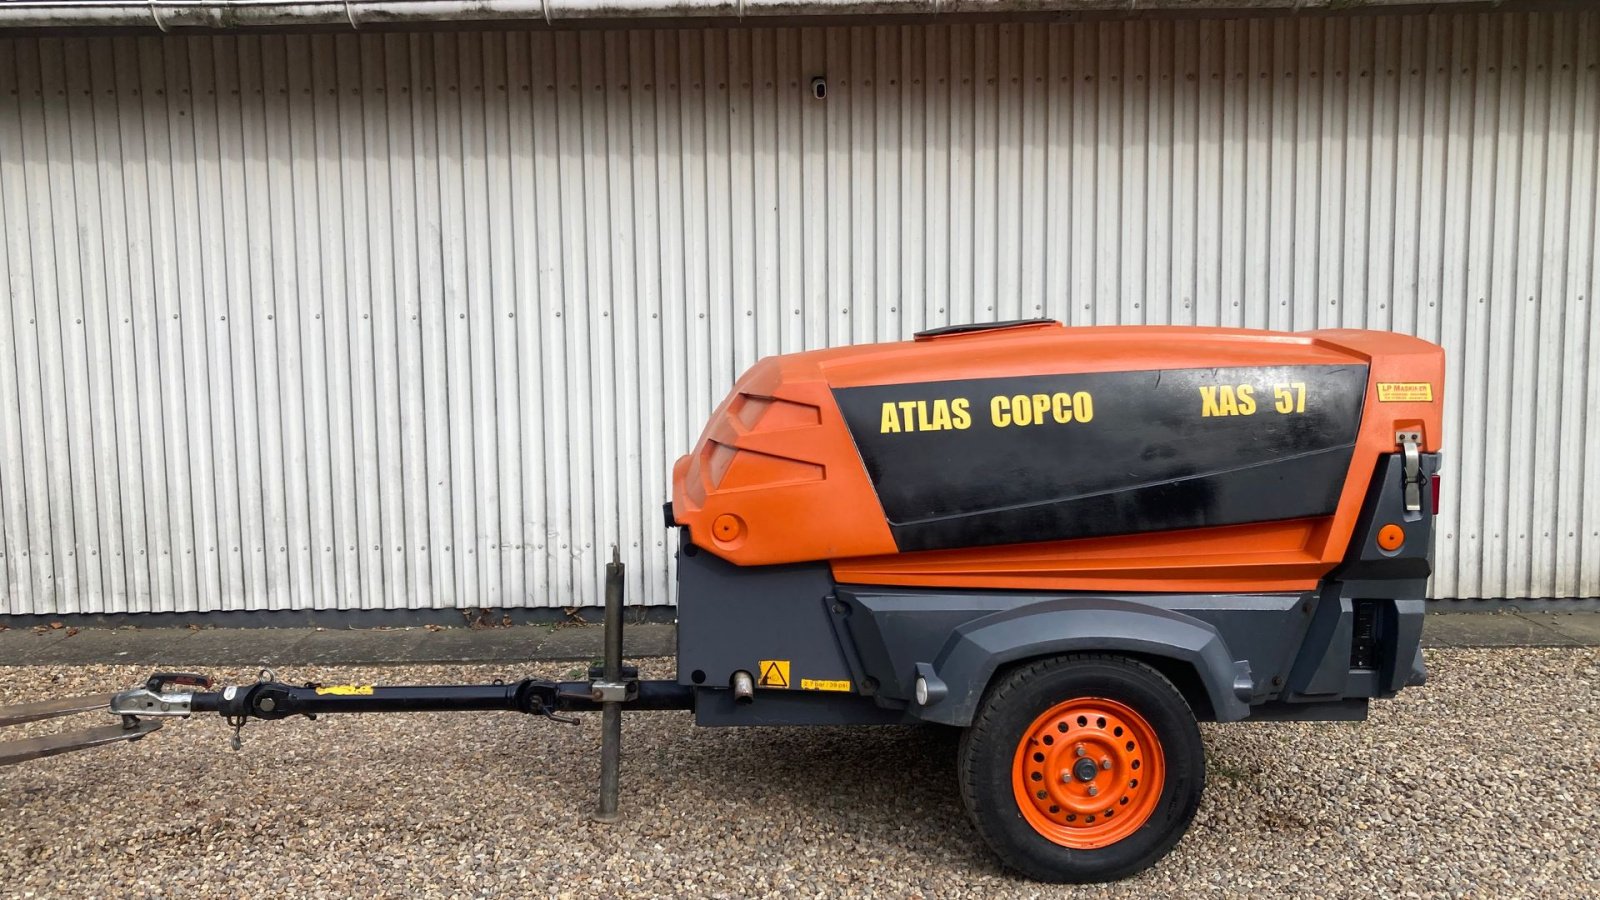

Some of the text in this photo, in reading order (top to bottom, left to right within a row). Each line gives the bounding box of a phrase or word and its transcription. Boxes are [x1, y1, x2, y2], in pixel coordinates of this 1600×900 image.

[880, 392, 1093, 434] ATLAS COPCO
[1199, 382, 1306, 417] XAS 57
